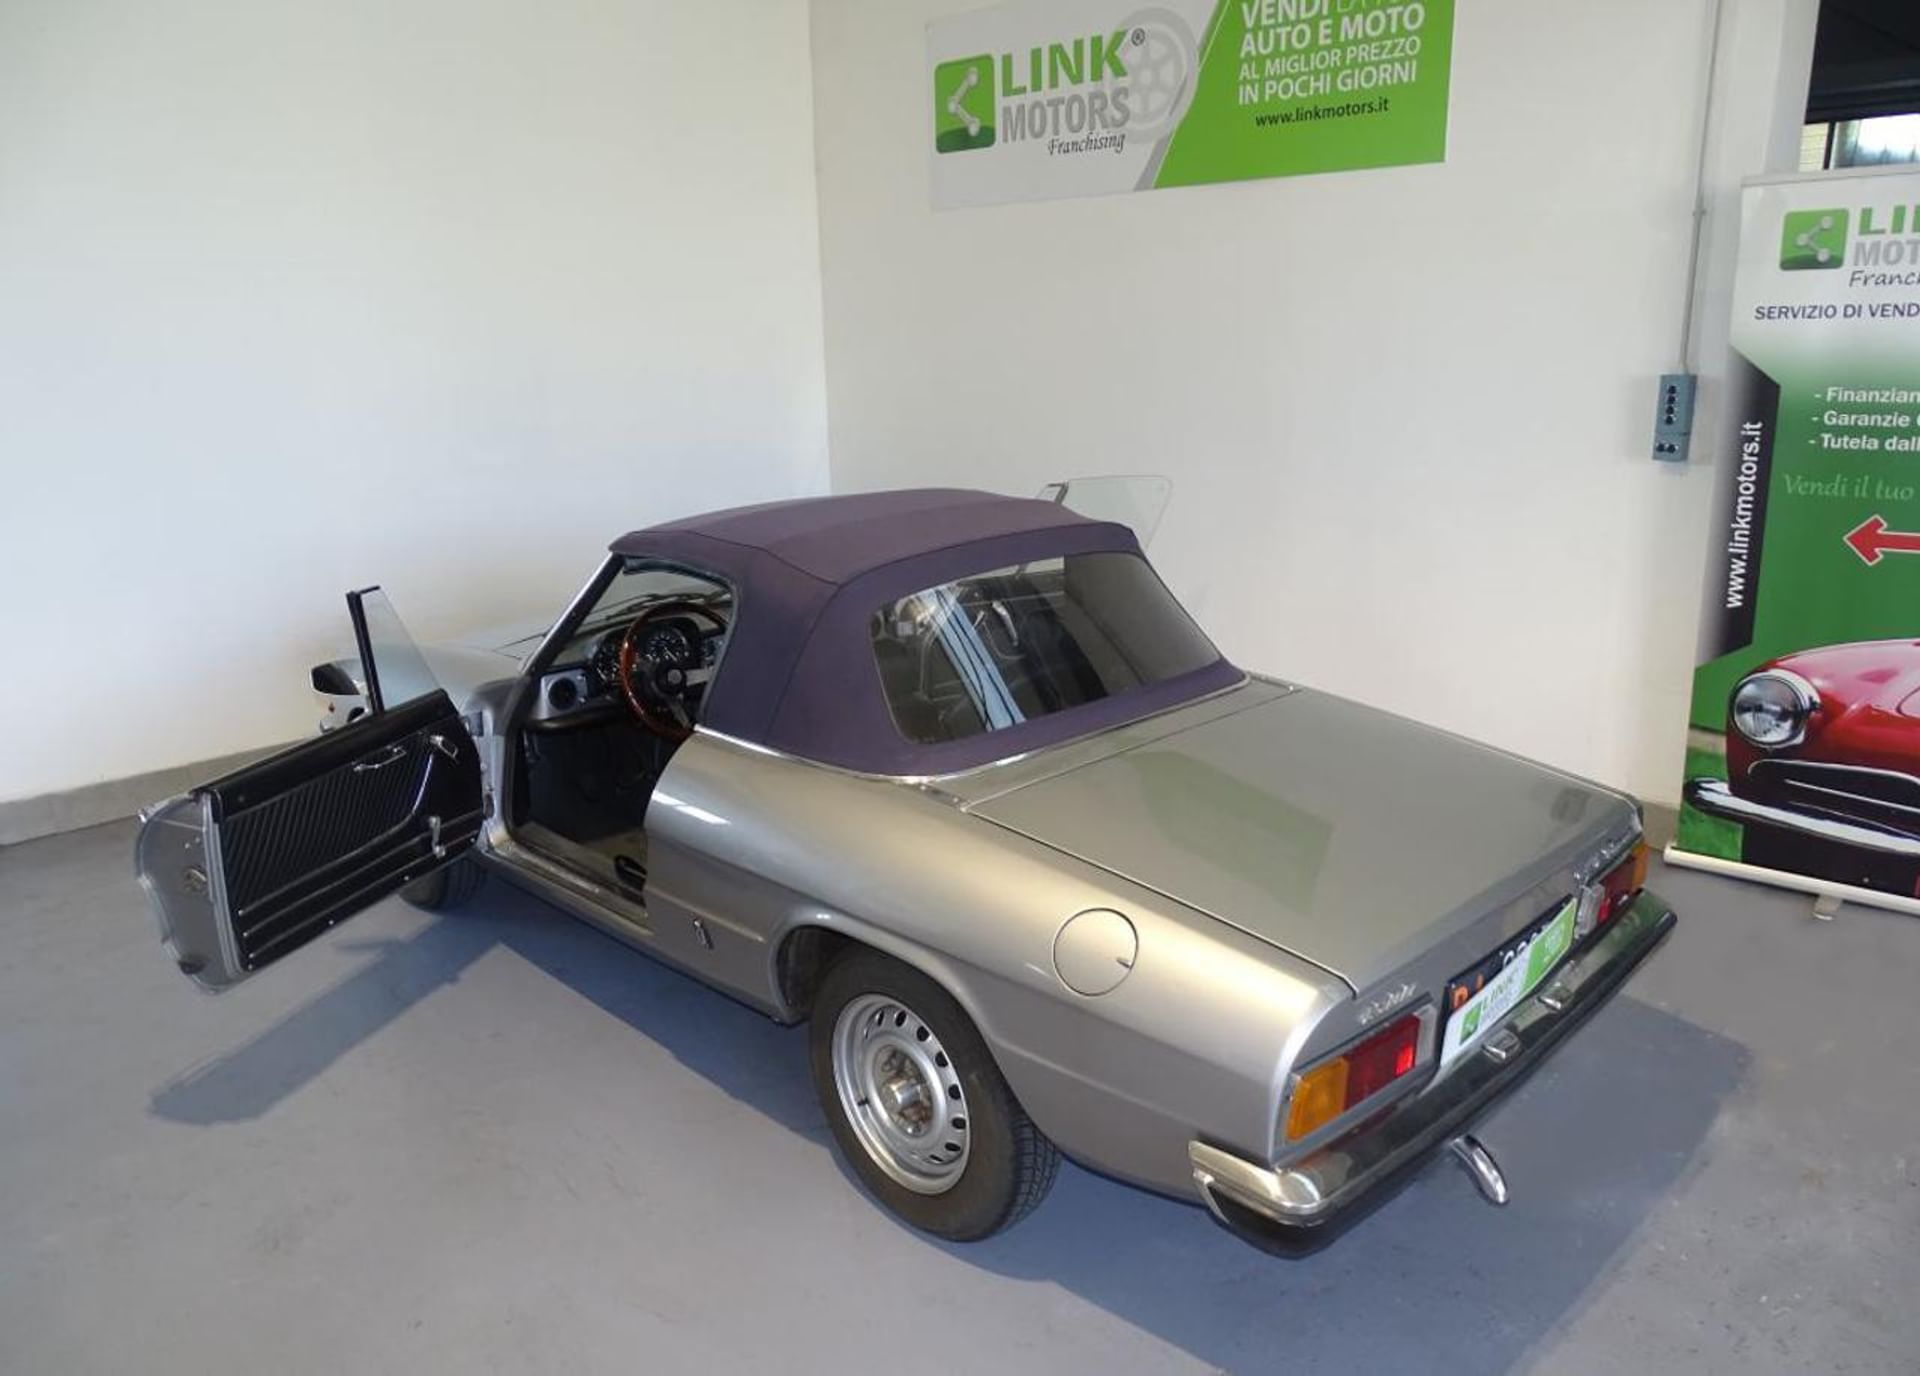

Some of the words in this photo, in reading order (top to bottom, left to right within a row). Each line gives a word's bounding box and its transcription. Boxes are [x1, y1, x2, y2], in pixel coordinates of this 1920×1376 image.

[1240, 23, 1311, 58] AUTO
[1319, 19, 1334, 45] E
[1340, 2, 1425, 42] MOTO
[1239, 61, 1260, 81] AL
[1265, 48, 1341, 77] MIGLIOR
[1345, 36, 1421, 66] PREZZO
[1239, 83, 1259, 105] IN
[1265, 73, 1331, 102] POCHI
[1337, 59, 1417, 92] GIORNI
[1002, 86, 1131, 143] MOTORS
[1255, 96, 1390, 127] www.linkmotors.it
[1048, 131, 1126, 155] Franchising
[1754, 304, 1838, 320] SERVIZIO
[1843, 303, 1862, 318] DI
[1867, 302, 1920, 318] VEND
[1823, 410, 1911, 427] Garanzie
[1820, 433, 1879, 450] Tutela
[1783, 473, 1848, 498] Vendi
[1854, 475, 1870, 498] il
[1875, 480, 1915, 500] tuo
[1726, 421, 1764, 608] www.linkmotors.it
